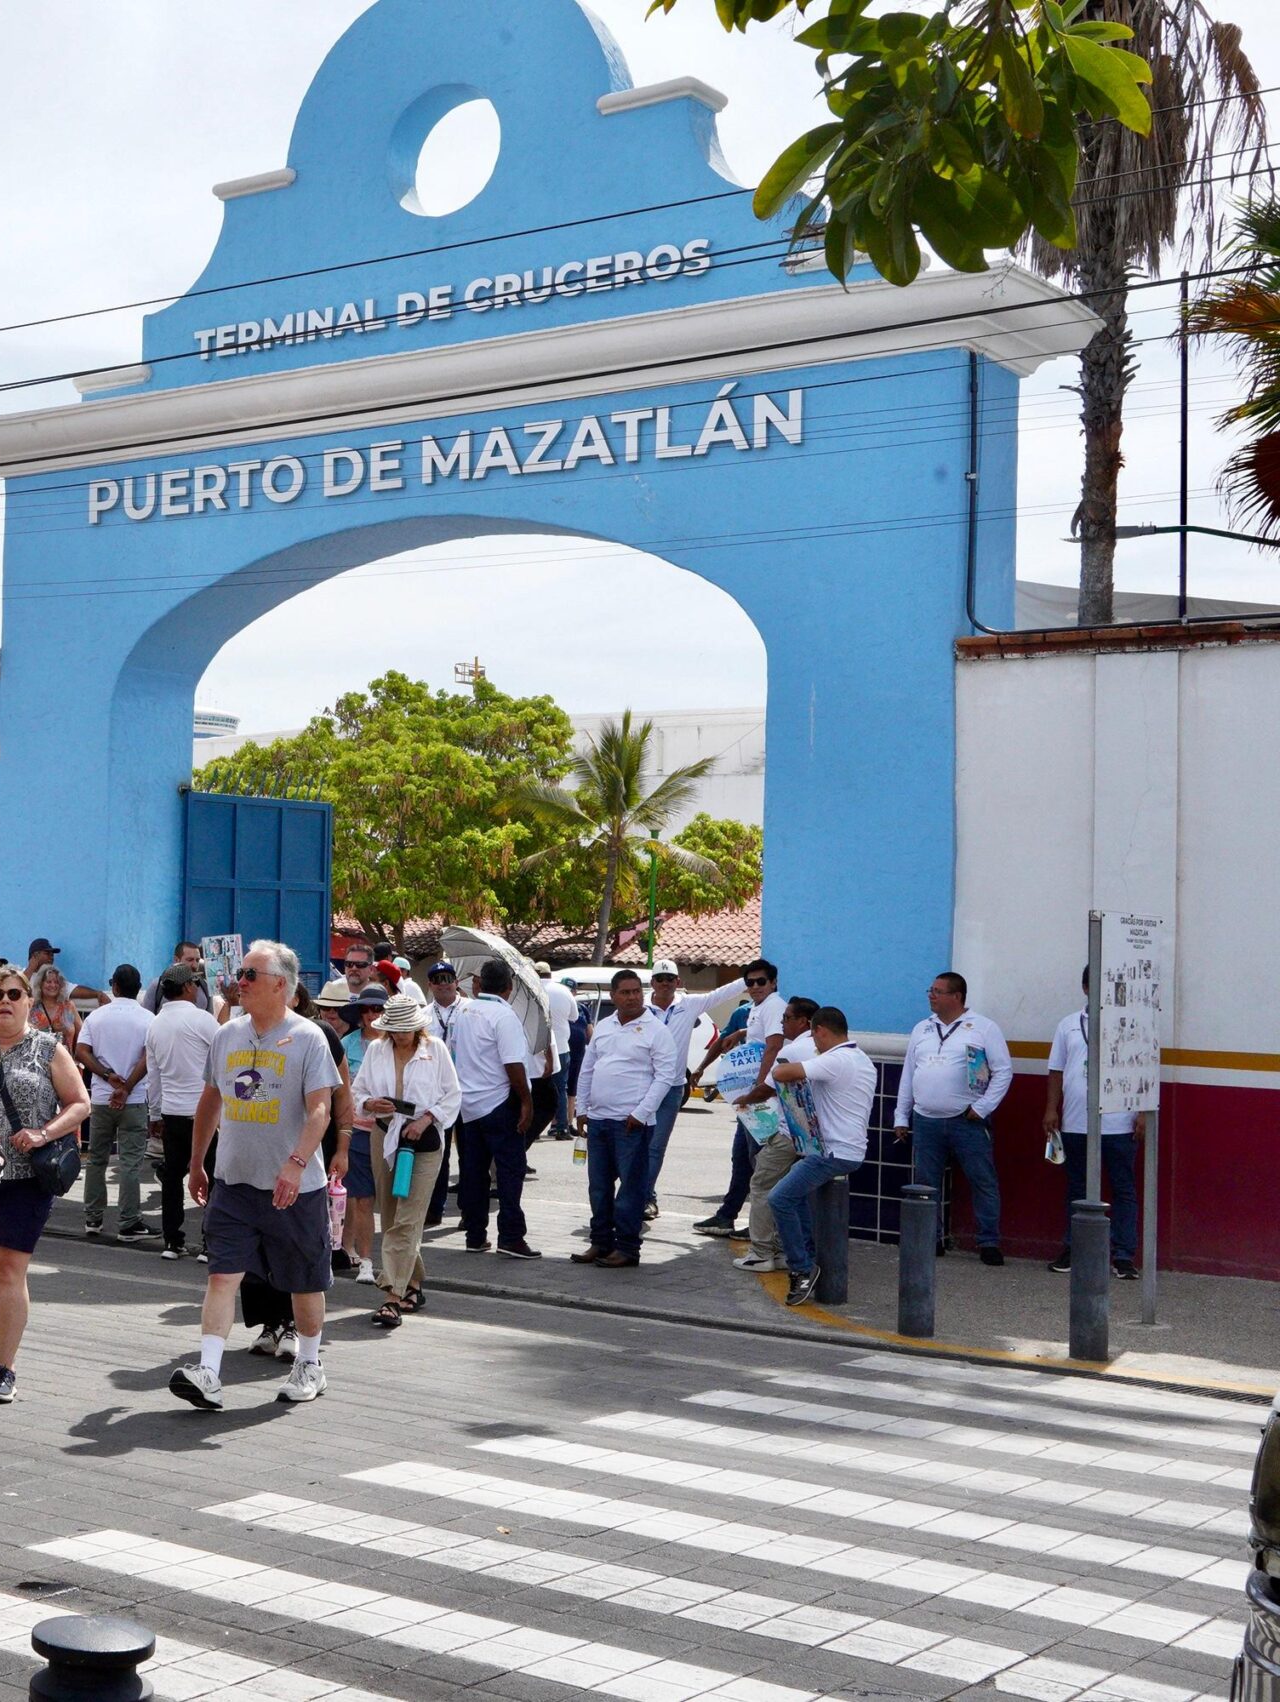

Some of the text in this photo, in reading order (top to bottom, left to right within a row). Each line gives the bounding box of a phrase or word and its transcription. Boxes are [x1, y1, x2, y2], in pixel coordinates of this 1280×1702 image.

[194, 238, 712, 361] TERMINAL DE CRUCEROS
[88, 382, 803, 525] PUERTO DE MAZATLÁN
[730, 1048, 755, 1060] SAFE
[731, 1056, 757, 1067] TAXI
